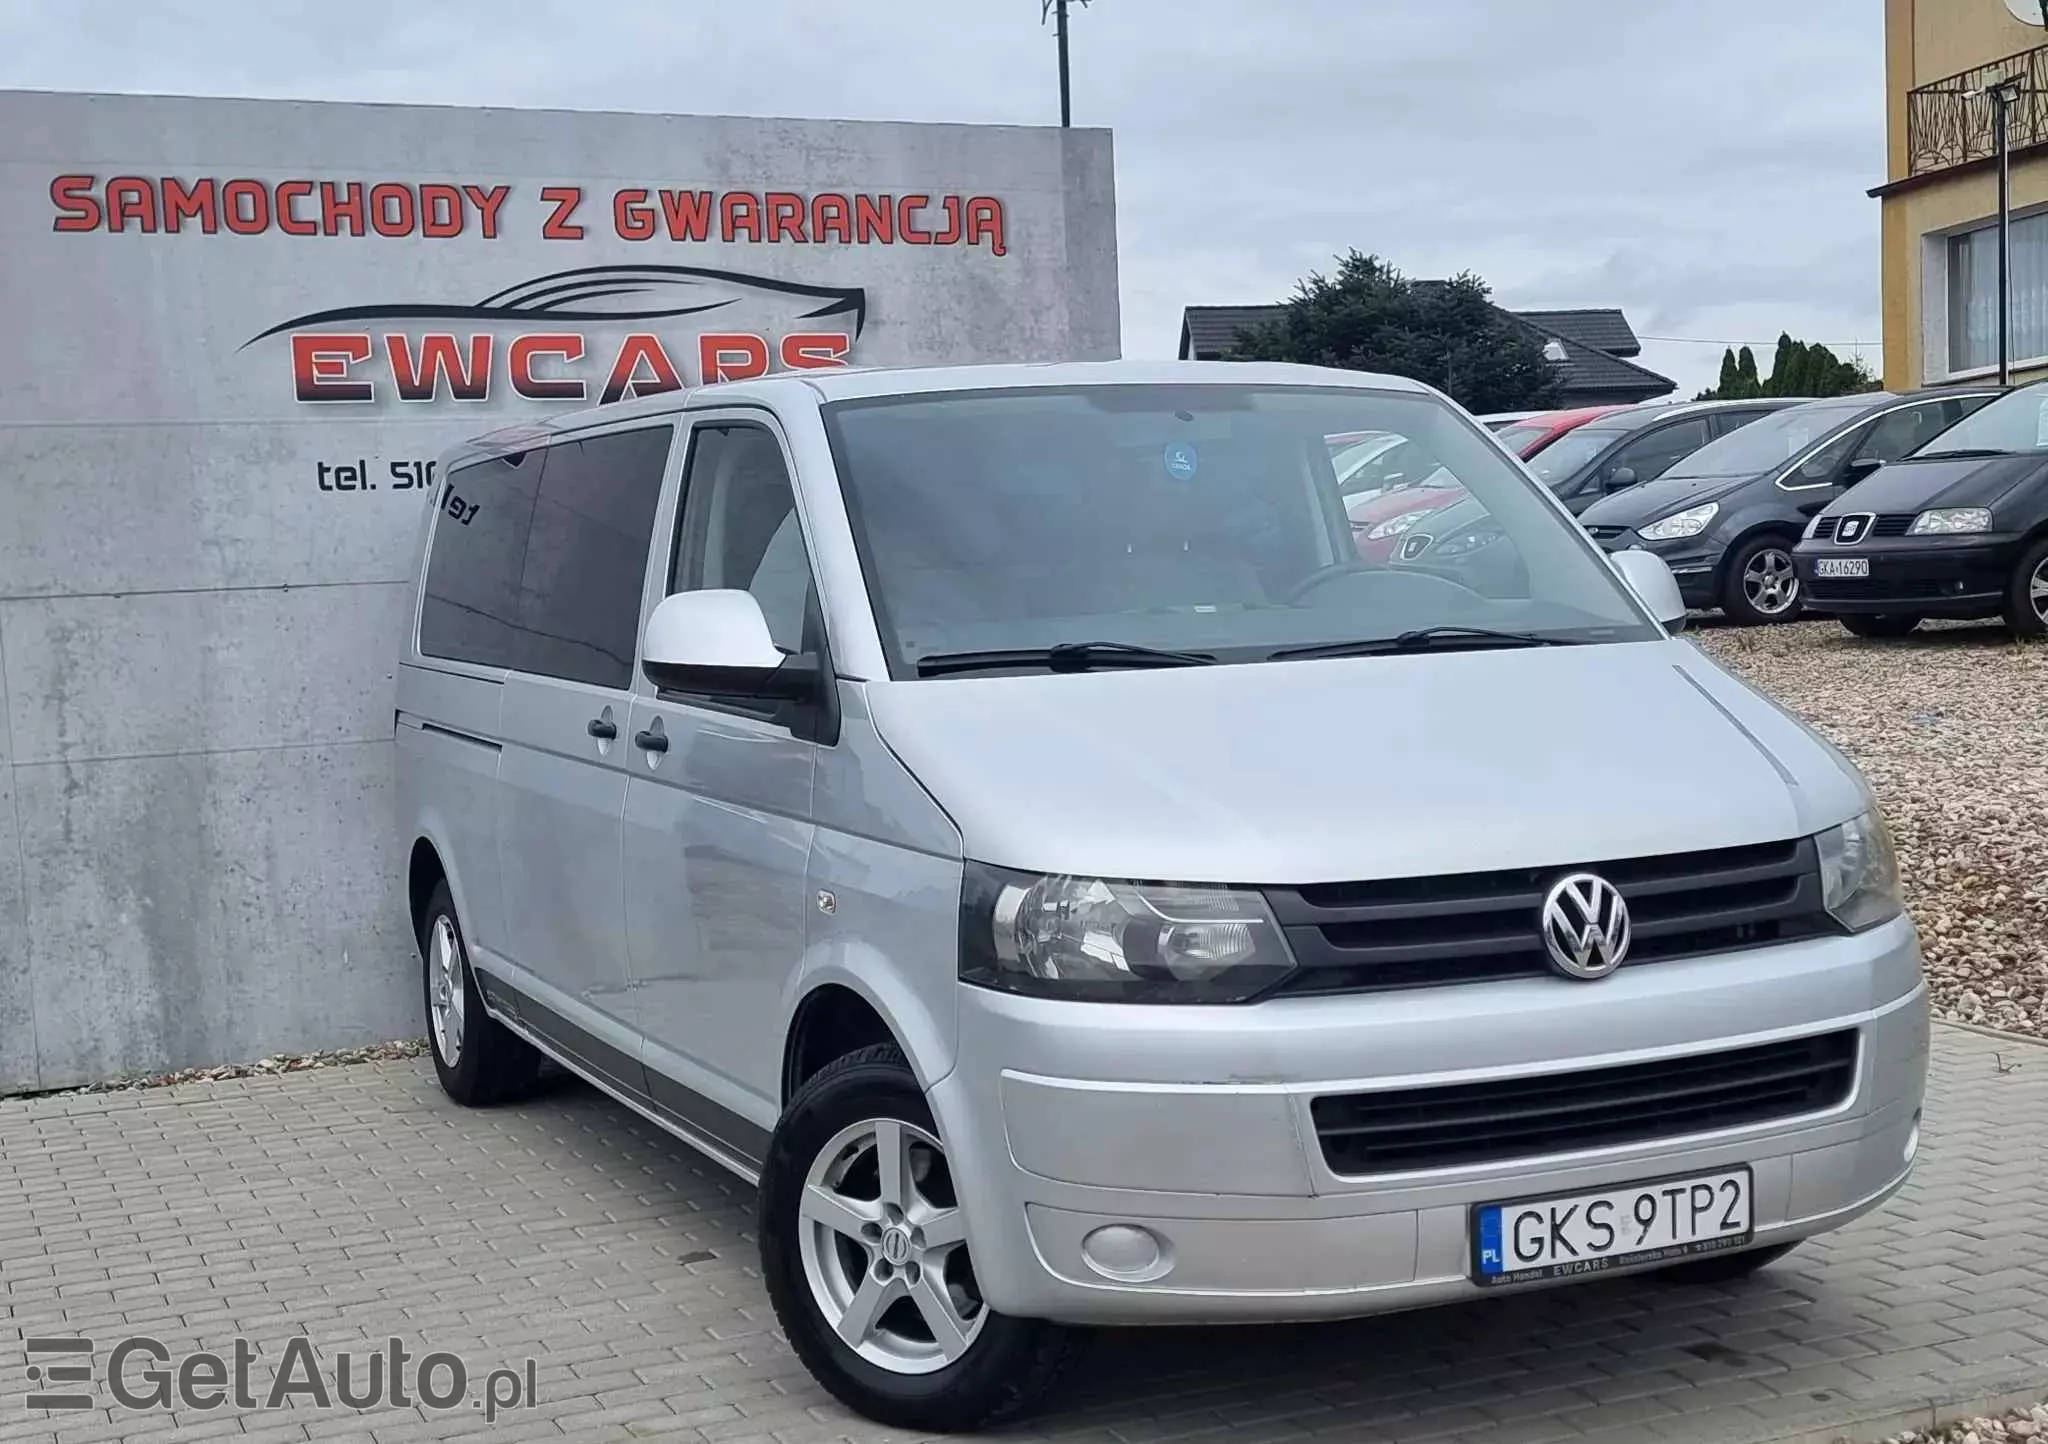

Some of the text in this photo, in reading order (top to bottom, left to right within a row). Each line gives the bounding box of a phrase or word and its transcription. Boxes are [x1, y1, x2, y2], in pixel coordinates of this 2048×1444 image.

[50, 175, 1006, 256] SAMOCHODY Z GWARANCJĄ
[317, 459, 376, 491] tel.
[1513, 1179, 1741, 1262] GKS 9TP2
[1482, 1249, 1500, 1265] PL
[1553, 1258, 1609, 1276] EWCARS
